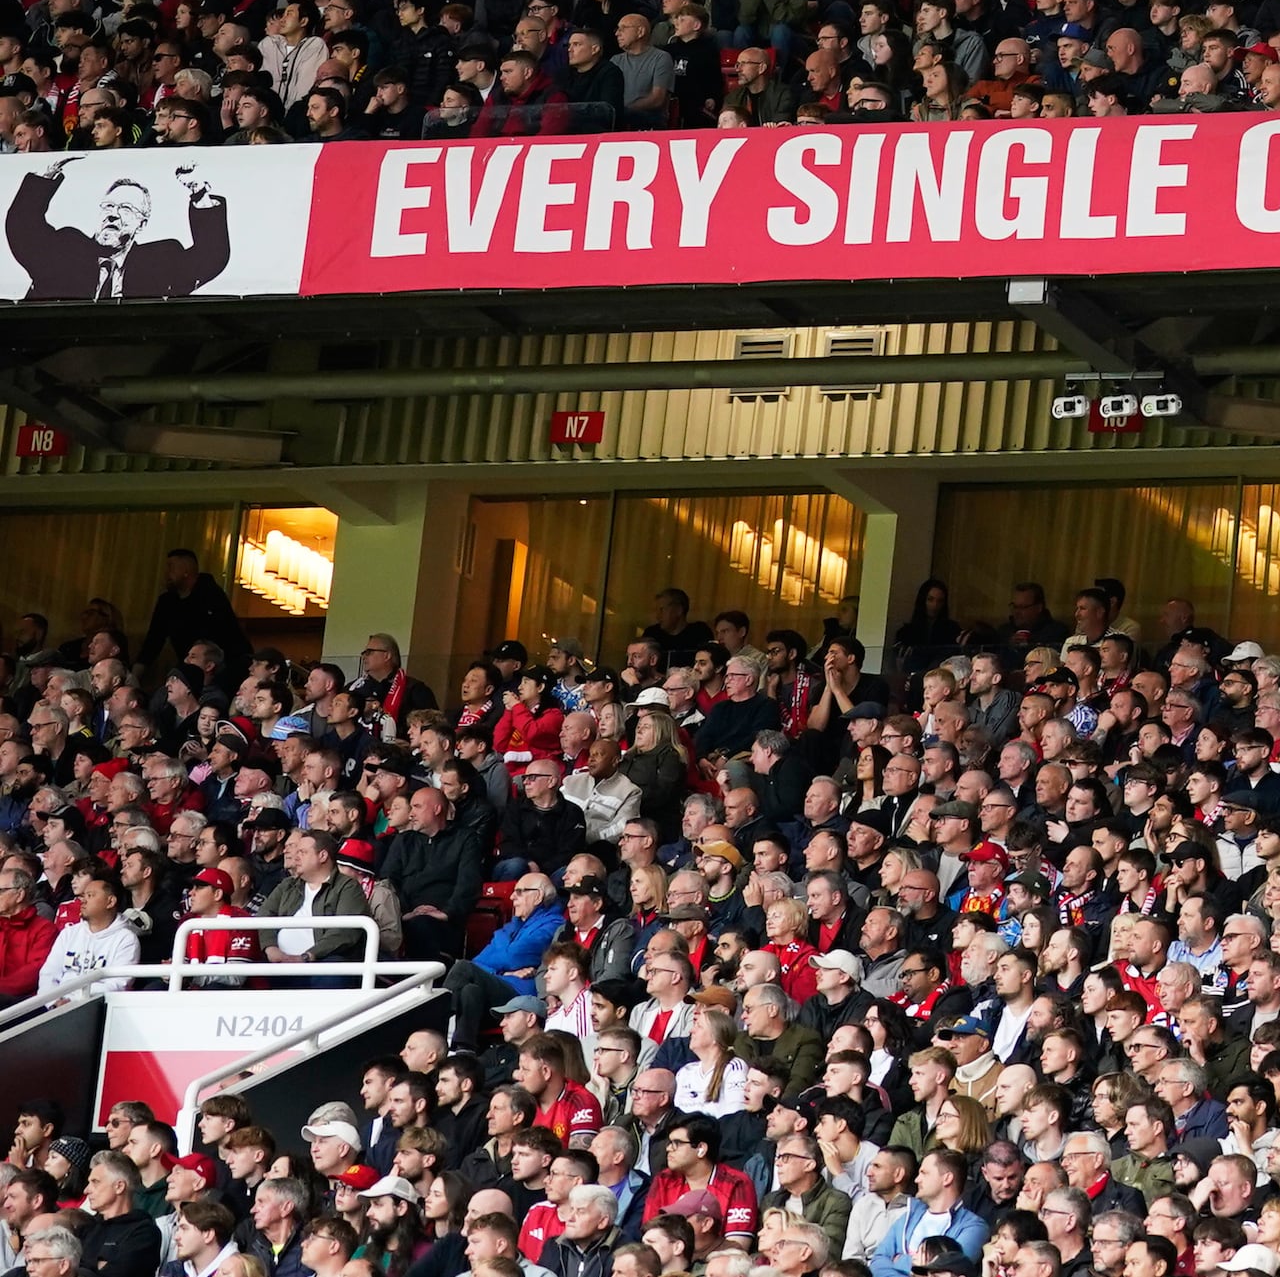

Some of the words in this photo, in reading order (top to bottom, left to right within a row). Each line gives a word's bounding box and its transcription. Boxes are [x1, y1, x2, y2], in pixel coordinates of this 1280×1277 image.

[371, 138, 747, 257] EVERY
[767, 125, 1197, 245] SINGLE
[565, 415, 589, 438] N7
[30, 429, 55, 452] N8
[215, 1015, 303, 1037] N2404
